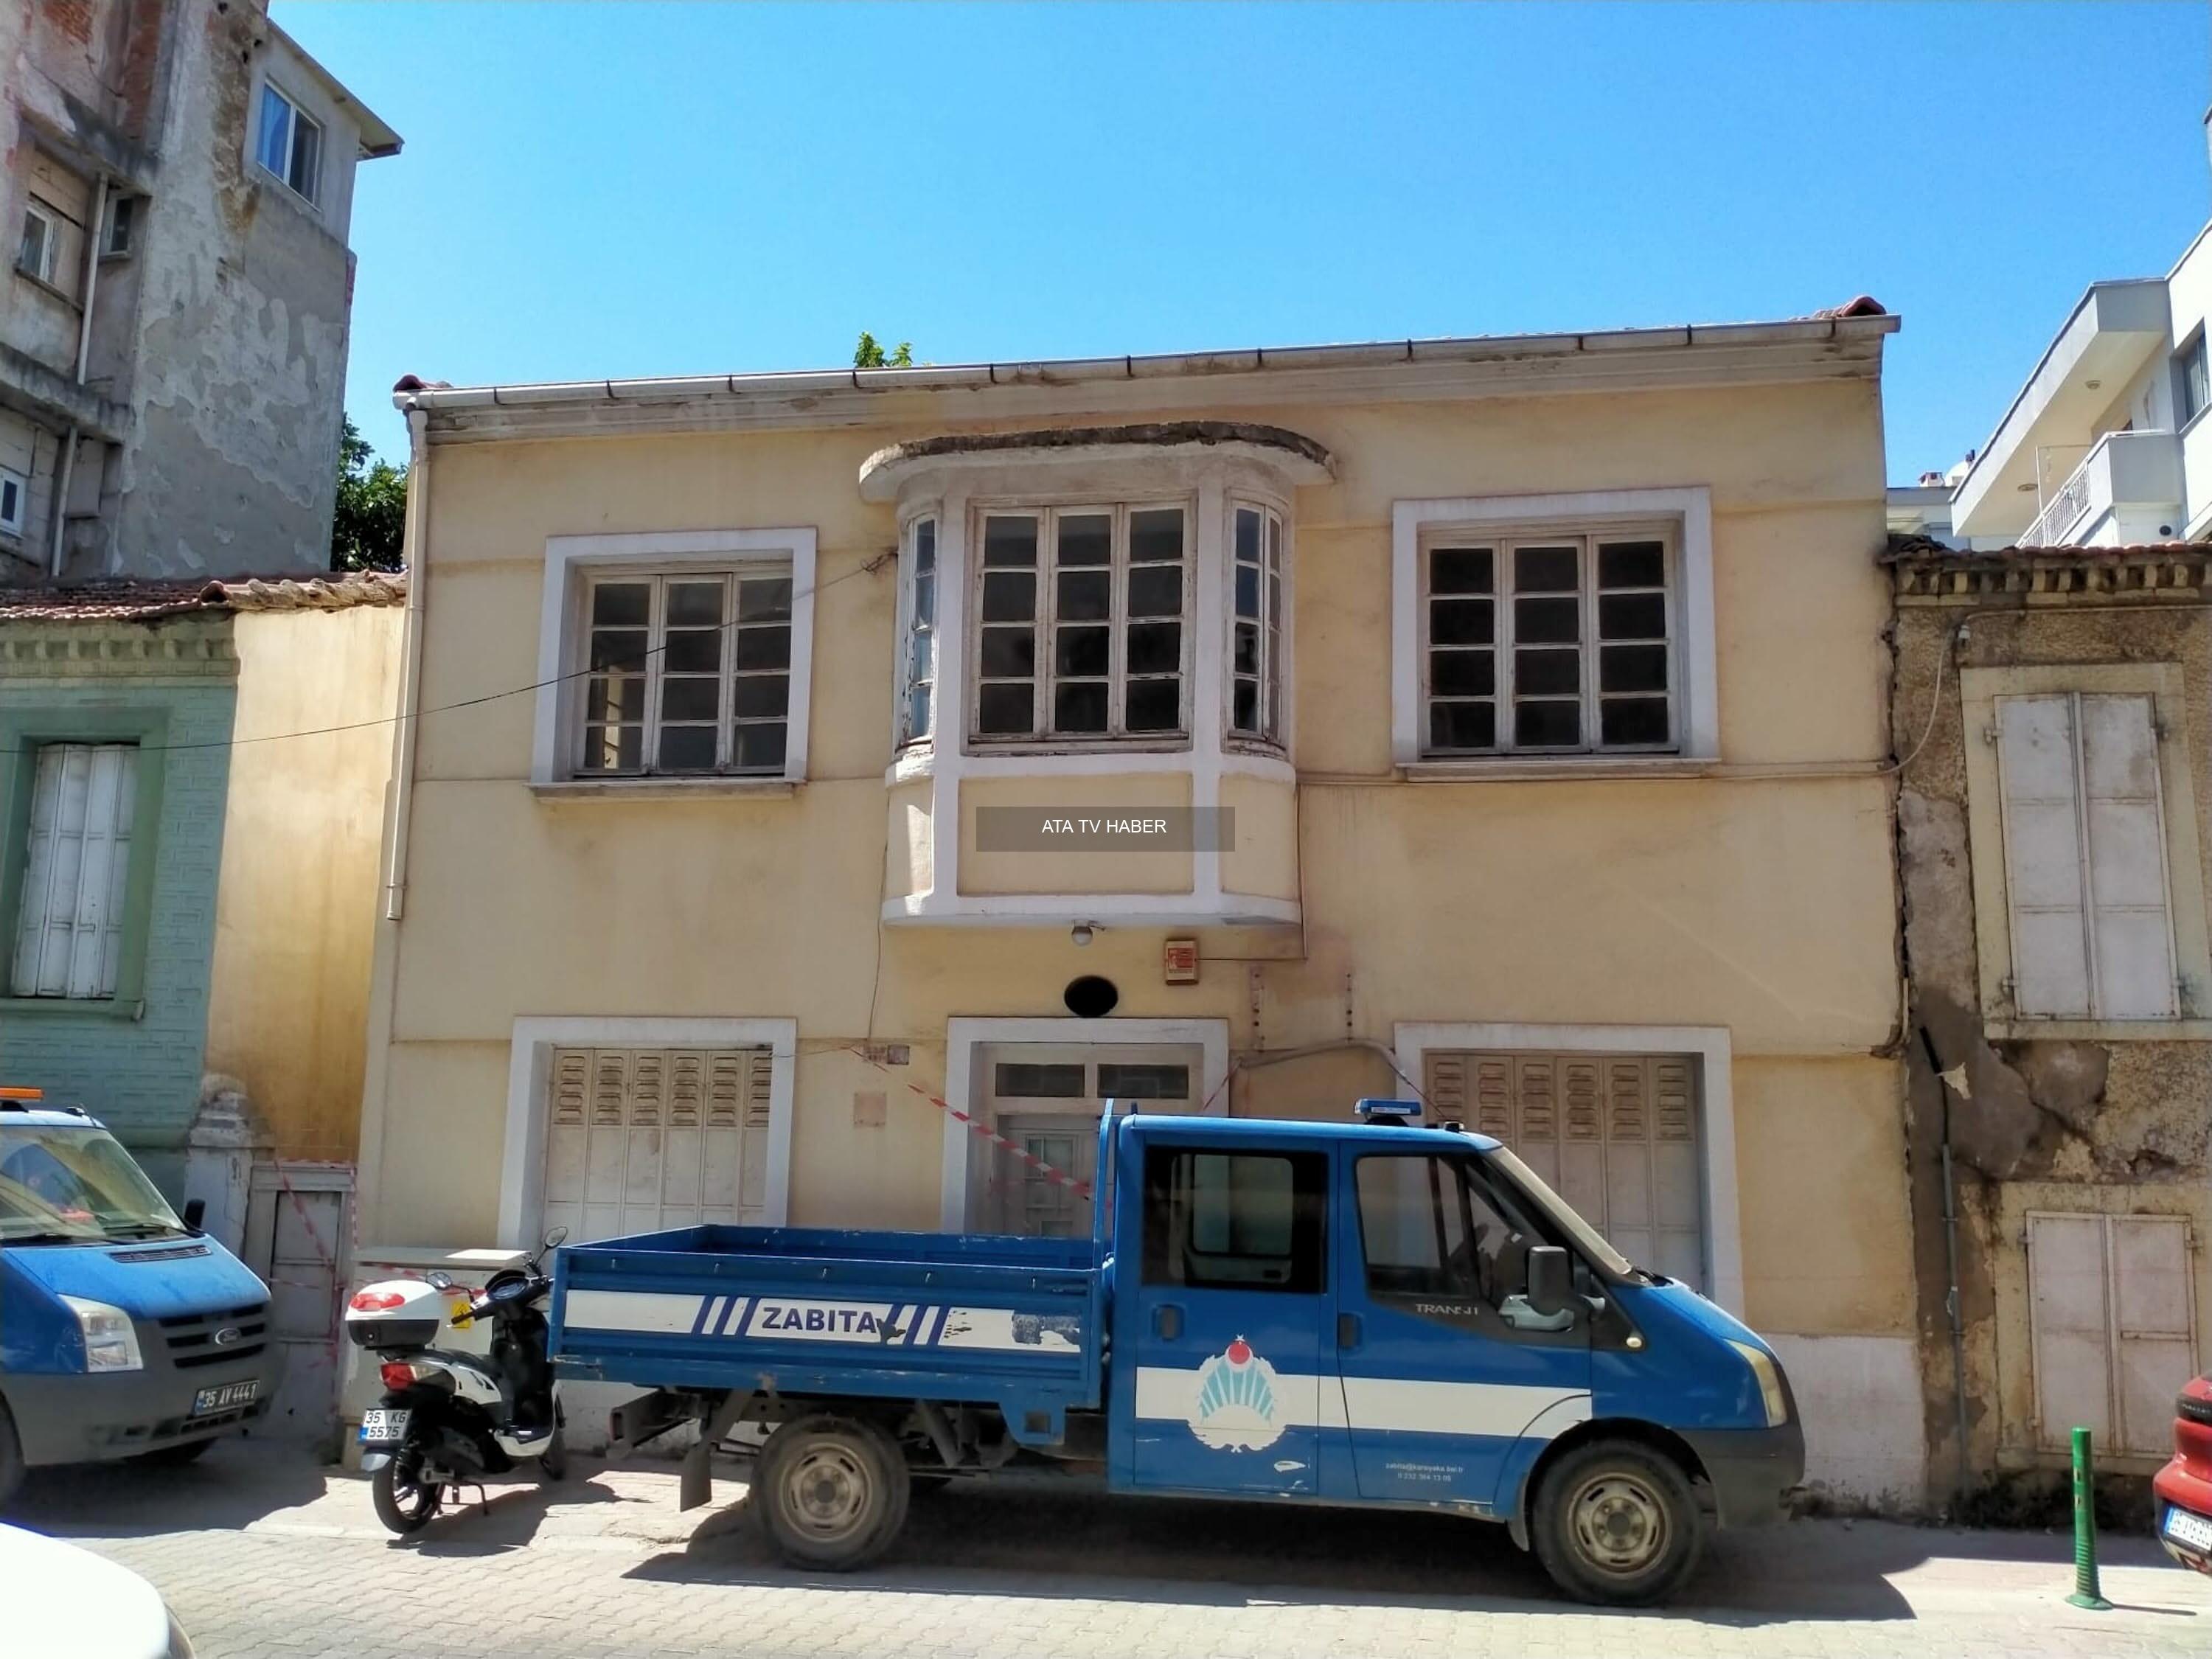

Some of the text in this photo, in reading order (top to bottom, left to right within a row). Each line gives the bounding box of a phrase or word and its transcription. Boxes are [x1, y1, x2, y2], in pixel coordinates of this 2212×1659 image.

[762, 1307, 877, 1334] ZABITA
[203, 1391, 218, 1408] 35
[366, 1412, 407, 1424] 35 KG
[369, 1426, 400, 1438] 5575
